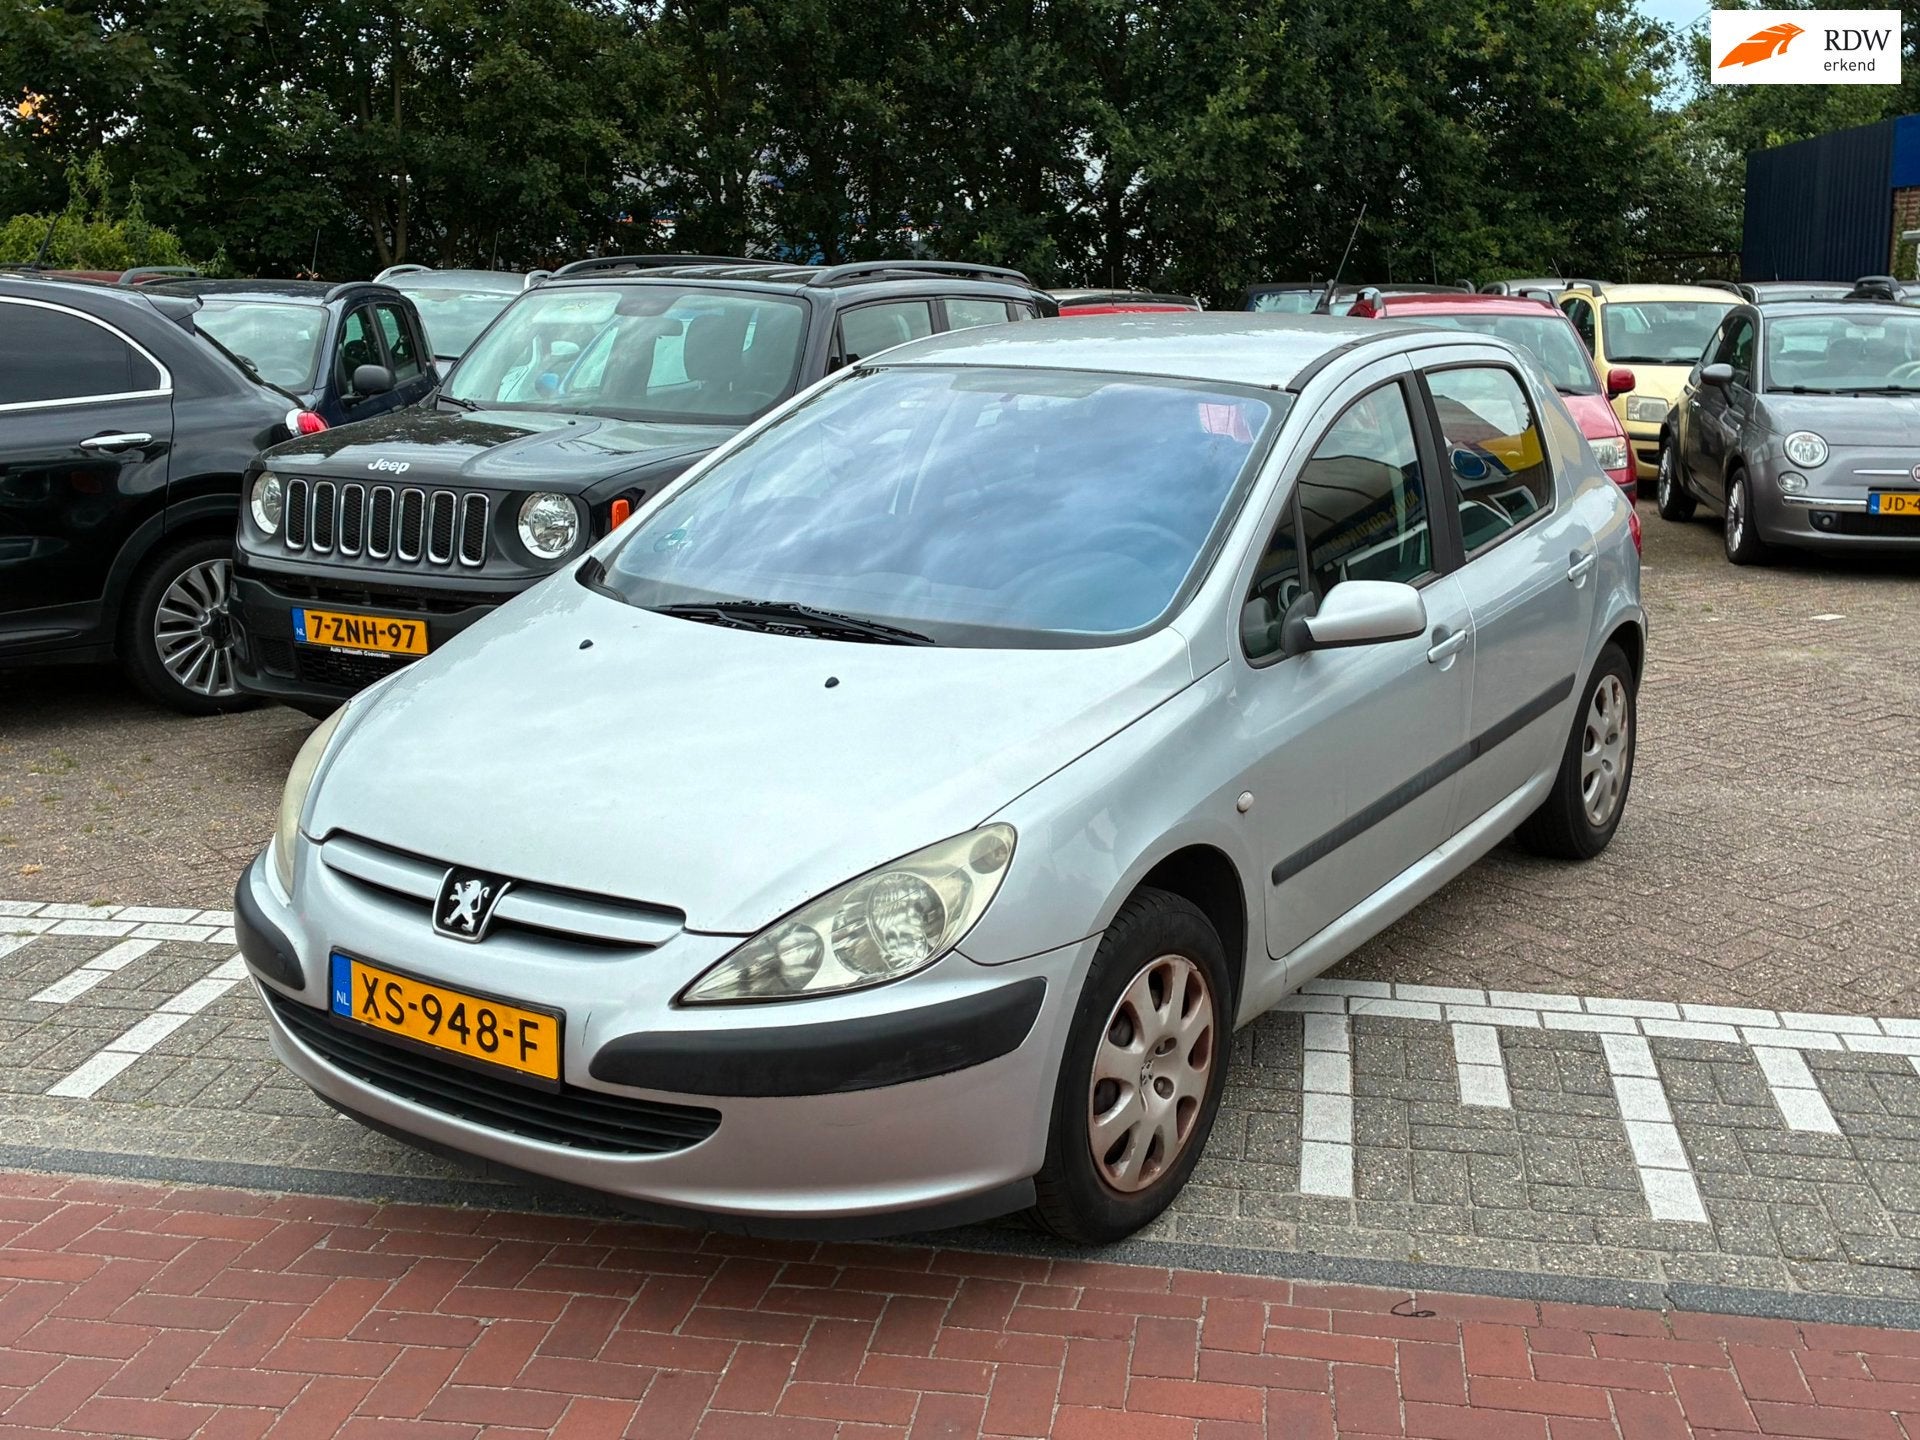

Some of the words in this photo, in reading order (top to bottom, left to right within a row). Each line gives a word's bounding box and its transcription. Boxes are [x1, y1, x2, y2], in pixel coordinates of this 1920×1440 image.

[367, 458, 410, 475] Jeep
[311, 615, 416, 649] 7-ZNH-97
[336, 990, 349, 1006] NL
[361, 972, 539, 1062] XS-948-F
